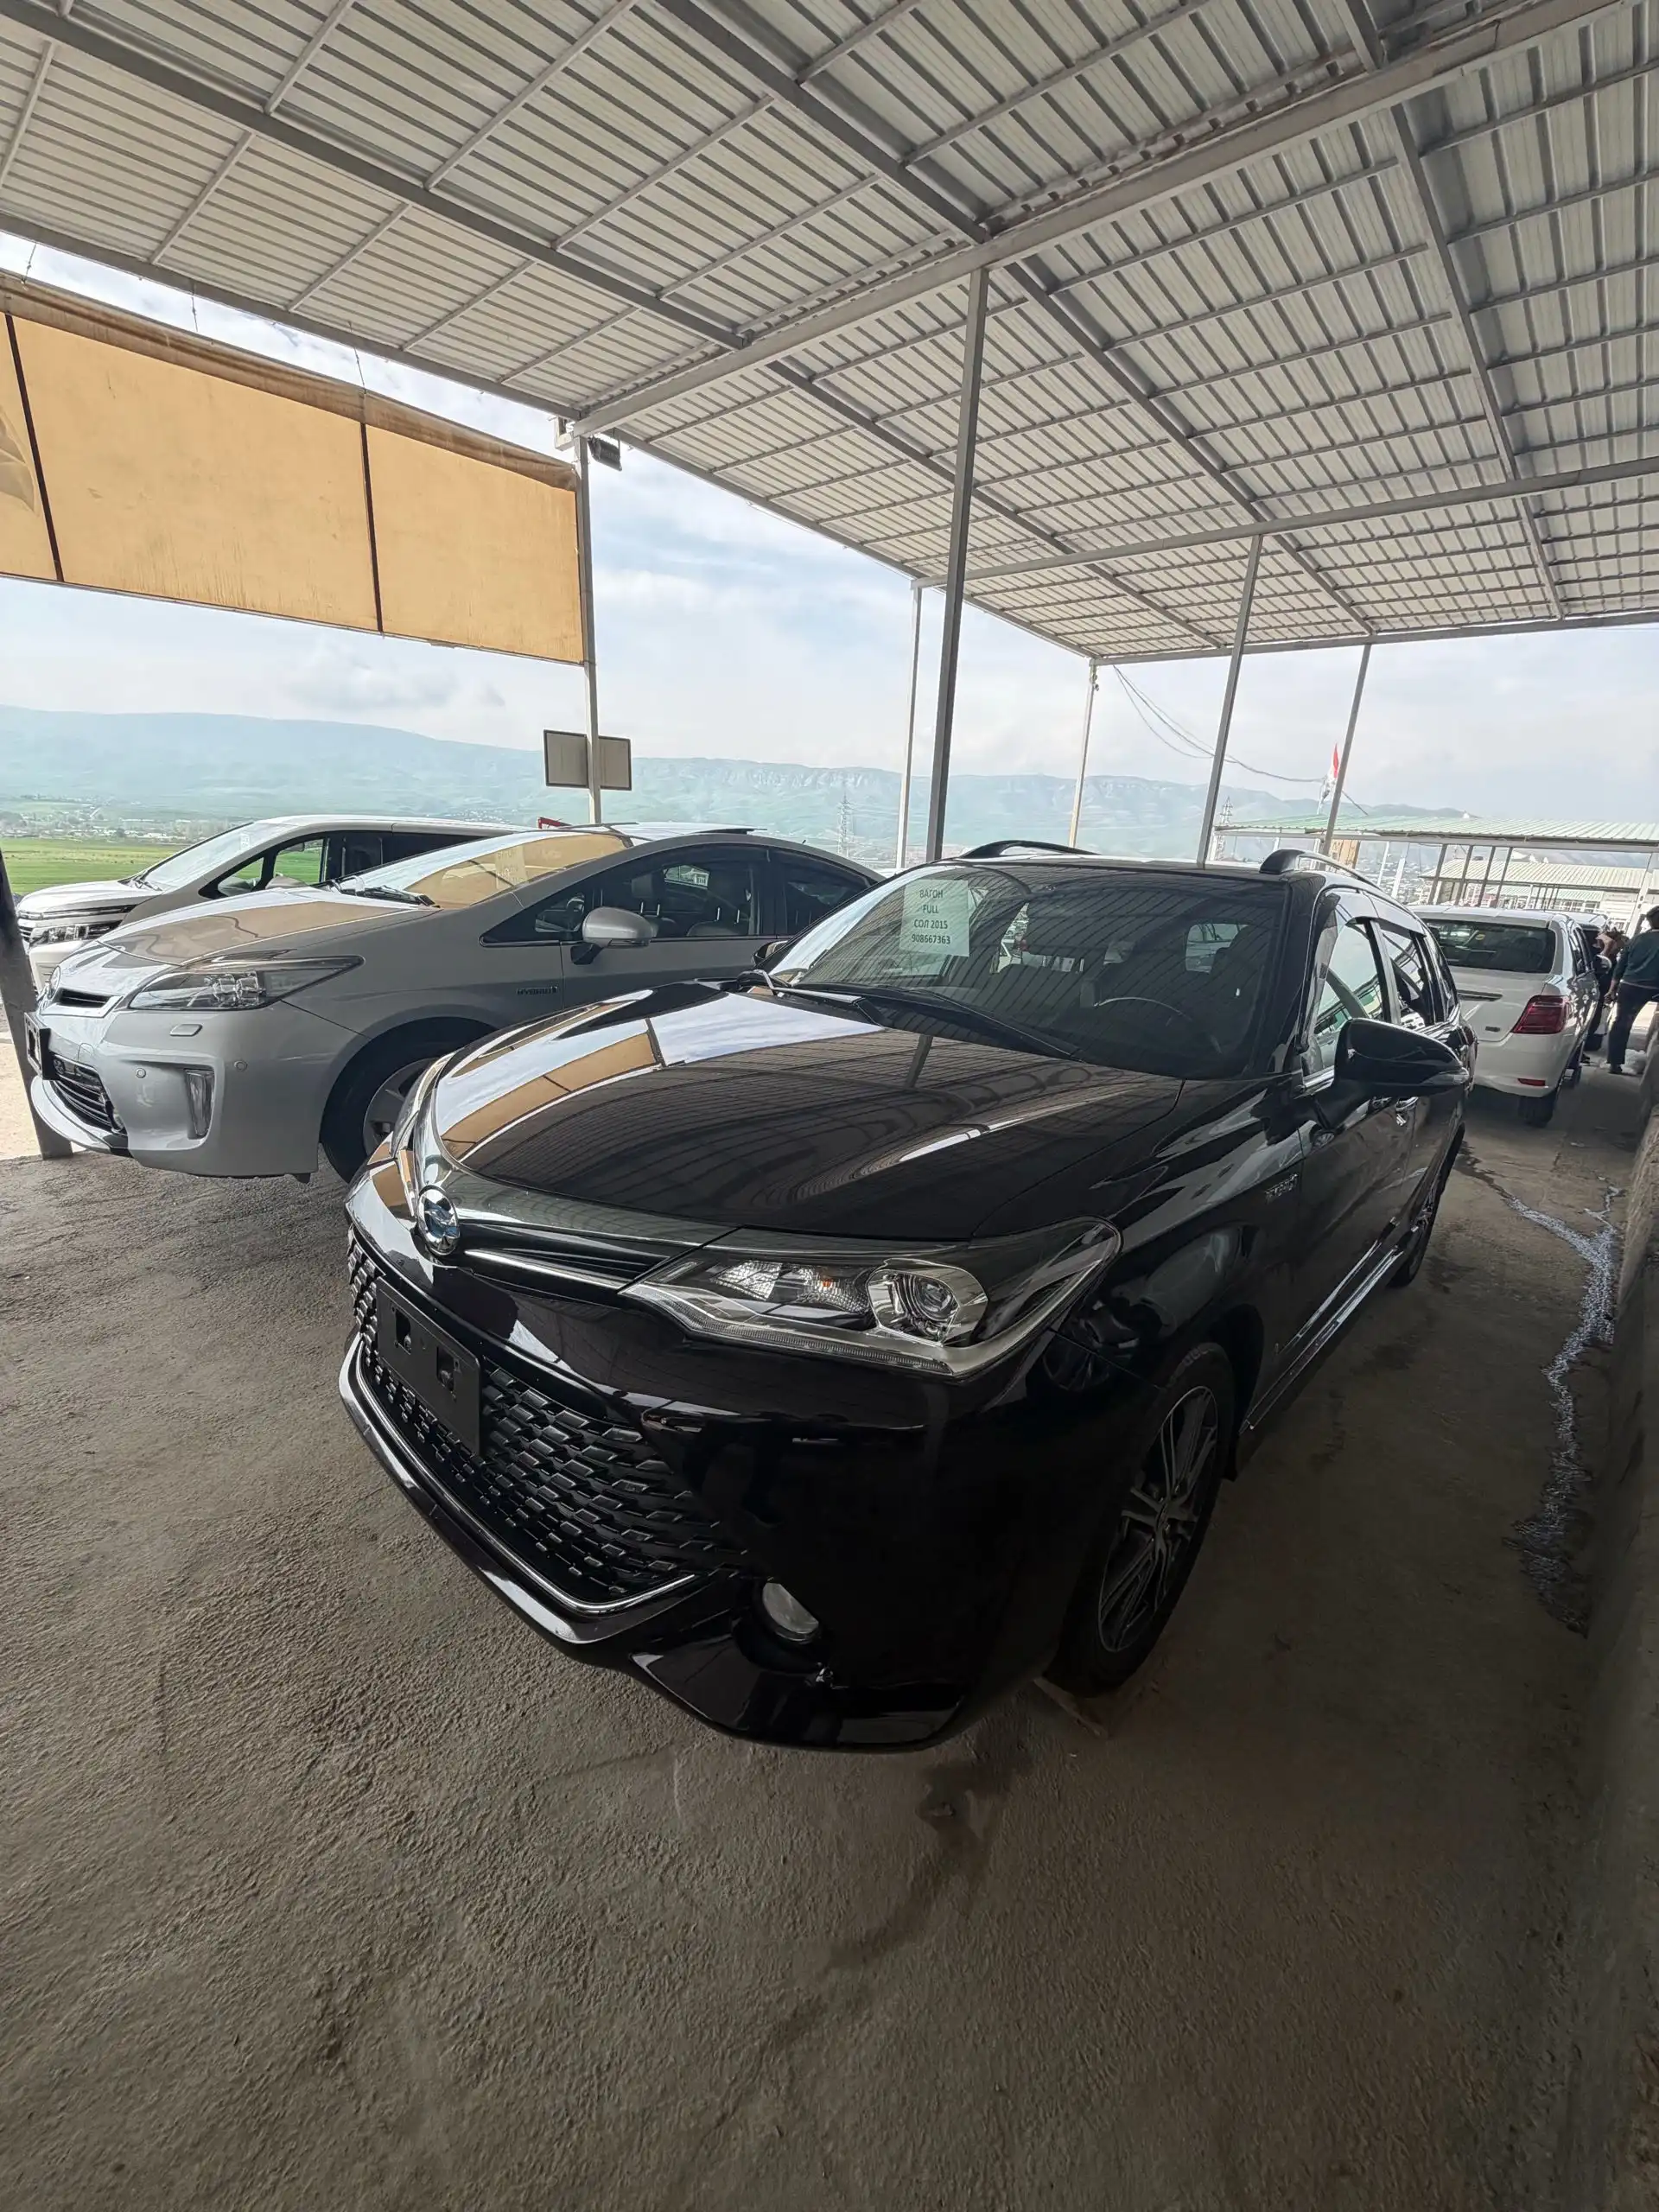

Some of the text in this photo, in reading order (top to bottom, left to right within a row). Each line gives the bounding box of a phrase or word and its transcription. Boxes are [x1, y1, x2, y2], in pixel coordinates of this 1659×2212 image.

[919, 889, 944, 899] ВАГОН
[922, 905, 939, 914] FULL
[913, 918, 949, 930] СОЛ 2015
[912, 933, 951, 944] 908667363
